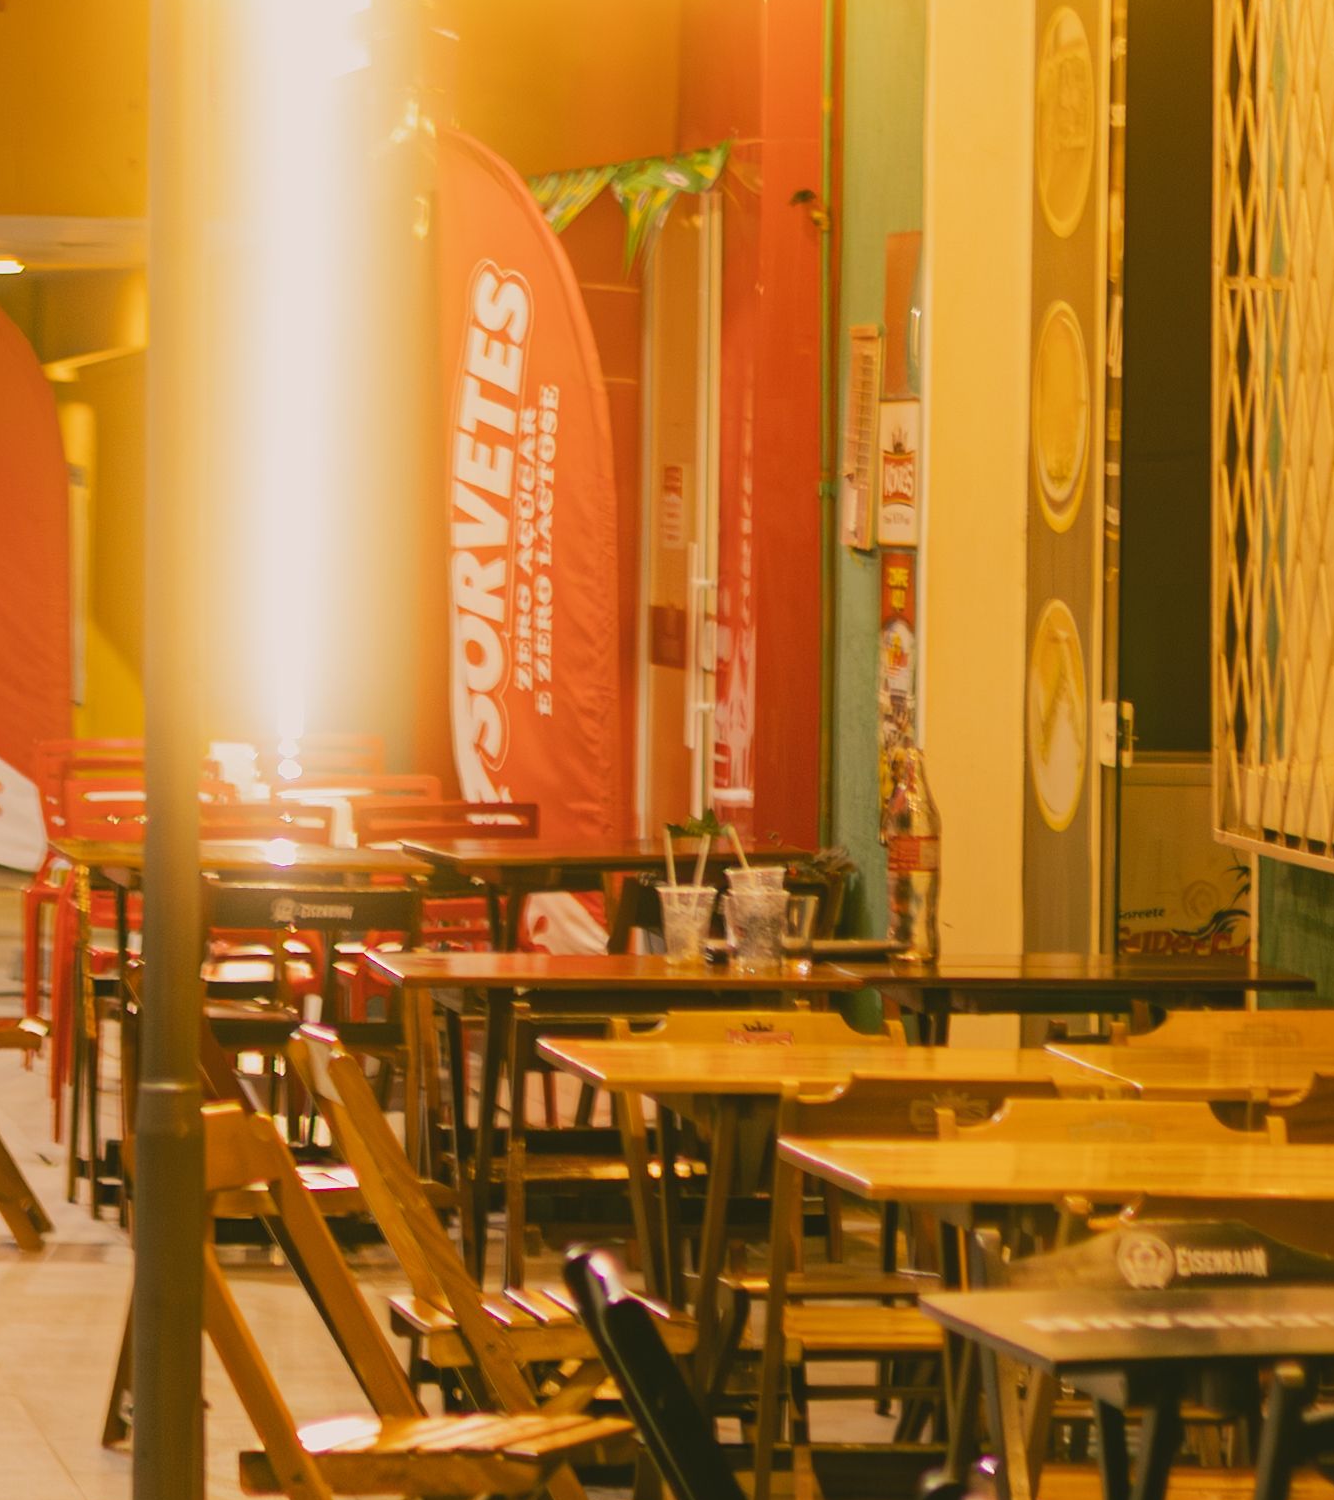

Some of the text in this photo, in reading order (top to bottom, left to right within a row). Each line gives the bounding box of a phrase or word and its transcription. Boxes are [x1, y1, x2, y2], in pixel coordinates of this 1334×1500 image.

[451, 265, 529, 763] SORVETES
[534, 384, 560, 716] E ZERO LACTOSE
[514, 583, 533, 692] ZERO
[1176, 1246, 1267, 1278] EISENBAHN
